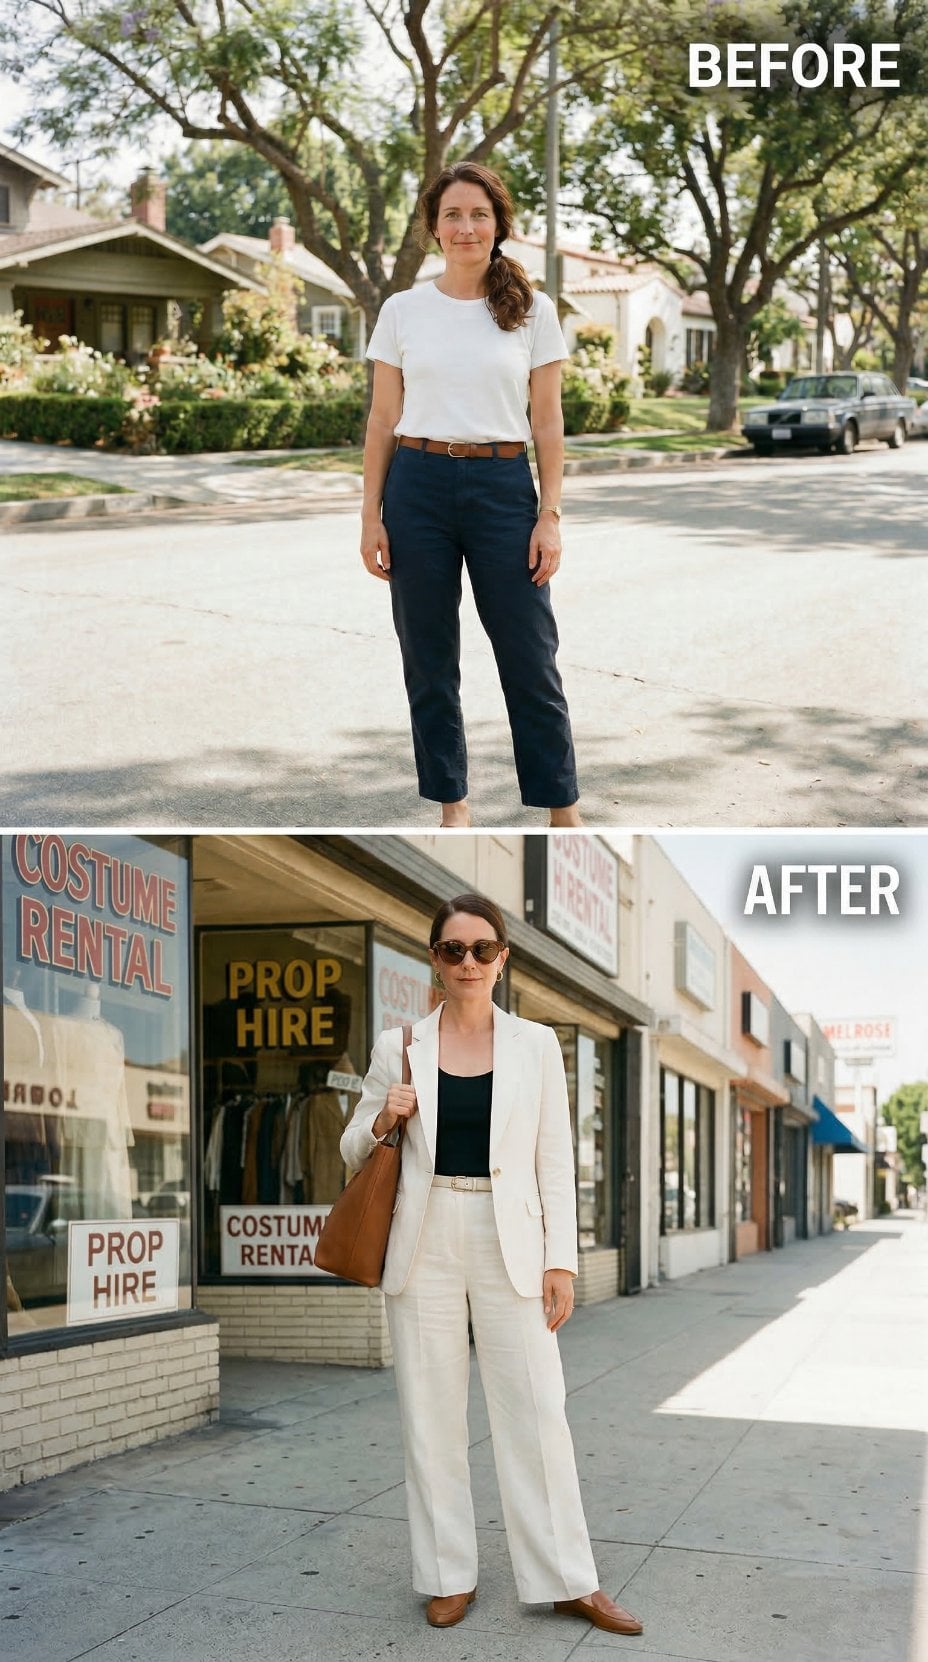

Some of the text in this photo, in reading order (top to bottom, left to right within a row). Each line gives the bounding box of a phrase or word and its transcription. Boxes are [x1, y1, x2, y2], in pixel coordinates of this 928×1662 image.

[15, 835, 177, 934] COSTUME
[20, 895, 173, 996] RENTAL
[227, 959, 342, 999] PROP
[236, 1006, 334, 1047] HIRE
[823, 1023, 891, 1040] MELROSE
[227, 1215, 330, 1238] COSTUM
[87, 1231, 163, 1267] PROP
[241, 1244, 314, 1266] RENTA
[93, 1271, 156, 1309] HIRE
